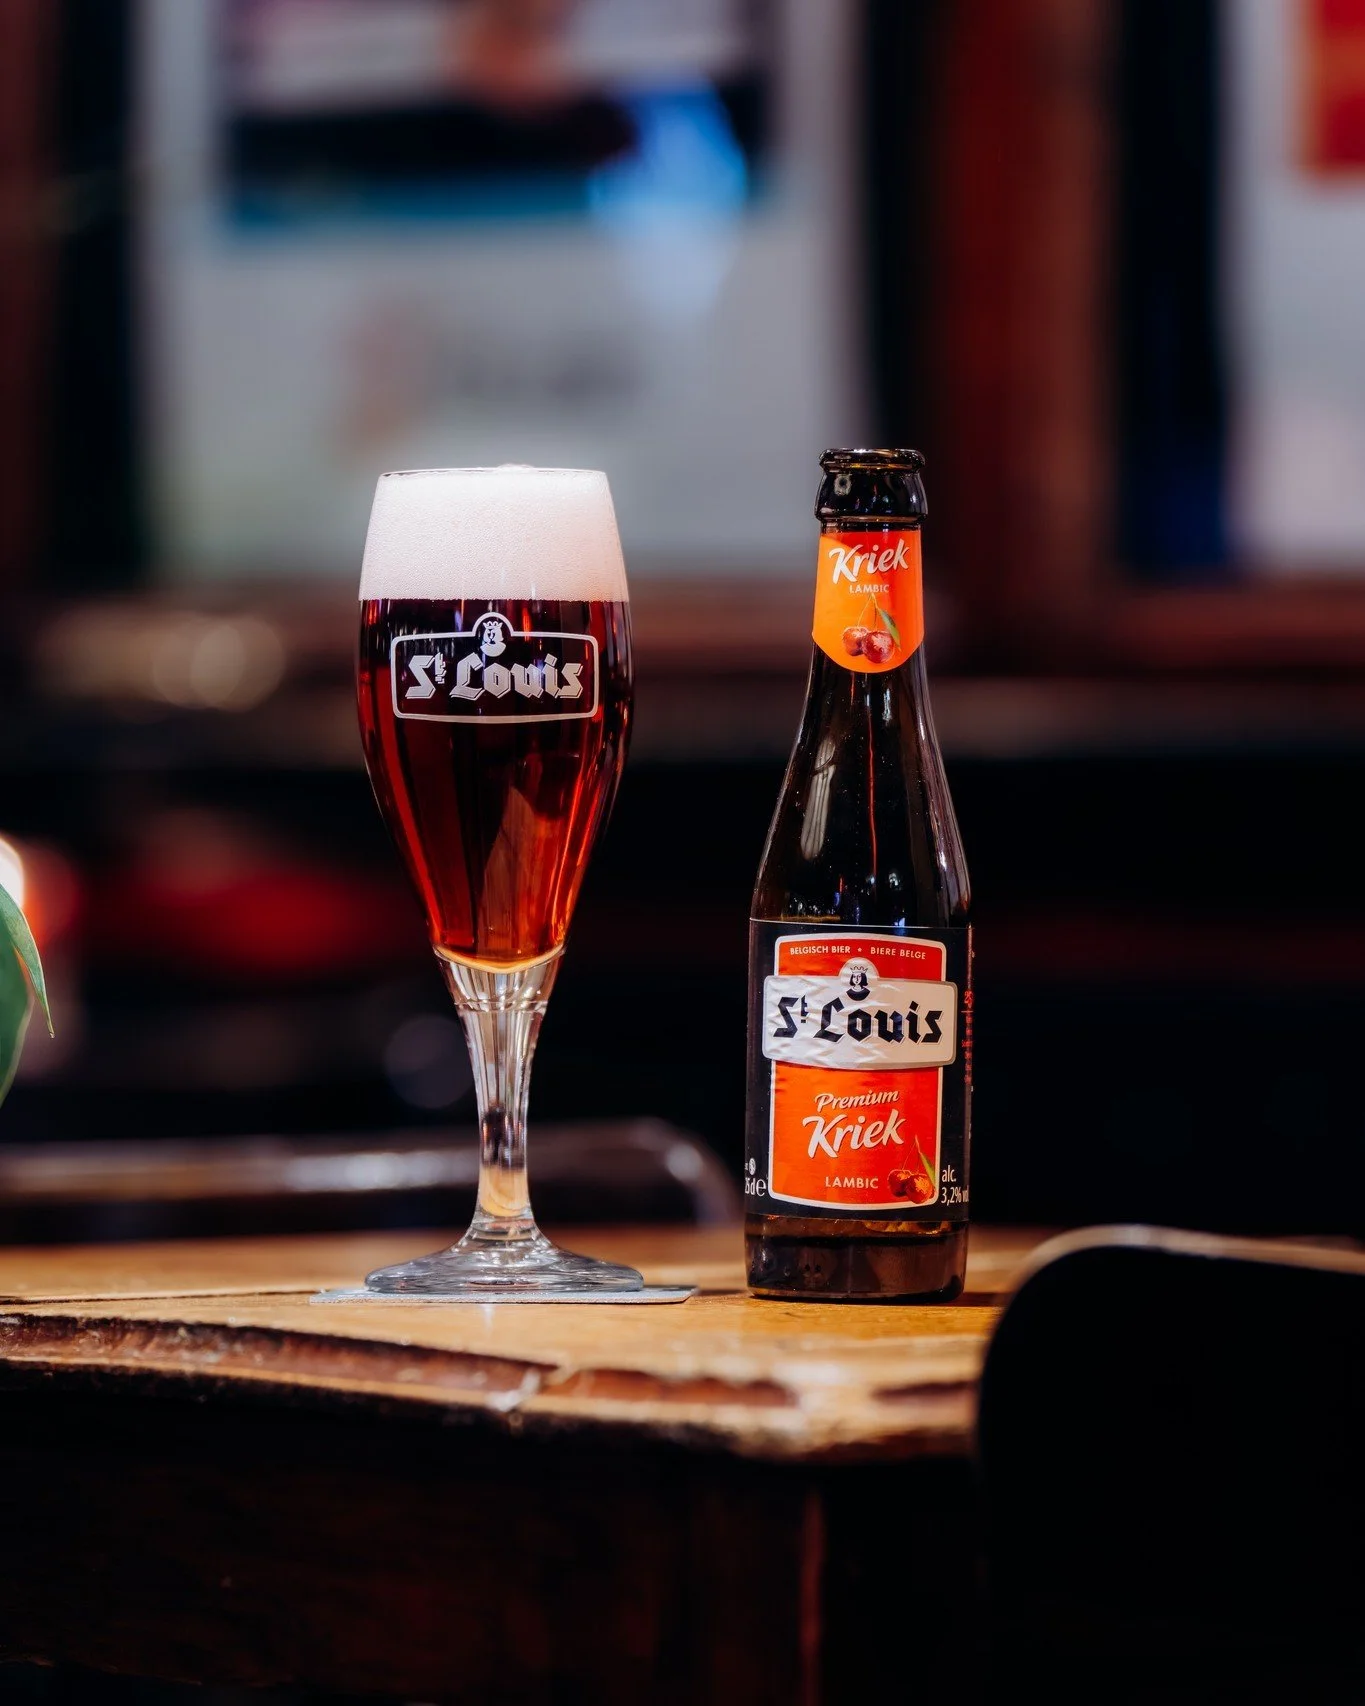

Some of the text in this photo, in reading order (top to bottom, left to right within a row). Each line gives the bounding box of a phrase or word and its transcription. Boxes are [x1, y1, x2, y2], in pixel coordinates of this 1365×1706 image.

[828, 538, 910, 584] Kriek
[849, 584, 890, 593] LAMBIC
[405, 651, 584, 701] St Louis
[790, 945, 926, 960] BELGISCH BIER BIERE BELGE
[773, 994, 810, 1039] St
[813, 996, 943, 1044] Louis
[814, 1089, 899, 1113] Premium
[802, 1108, 906, 1159] Kriek
[825, 1176, 879, 1189] LAMBIC
[940, 1185, 962, 1207] 3,2%
